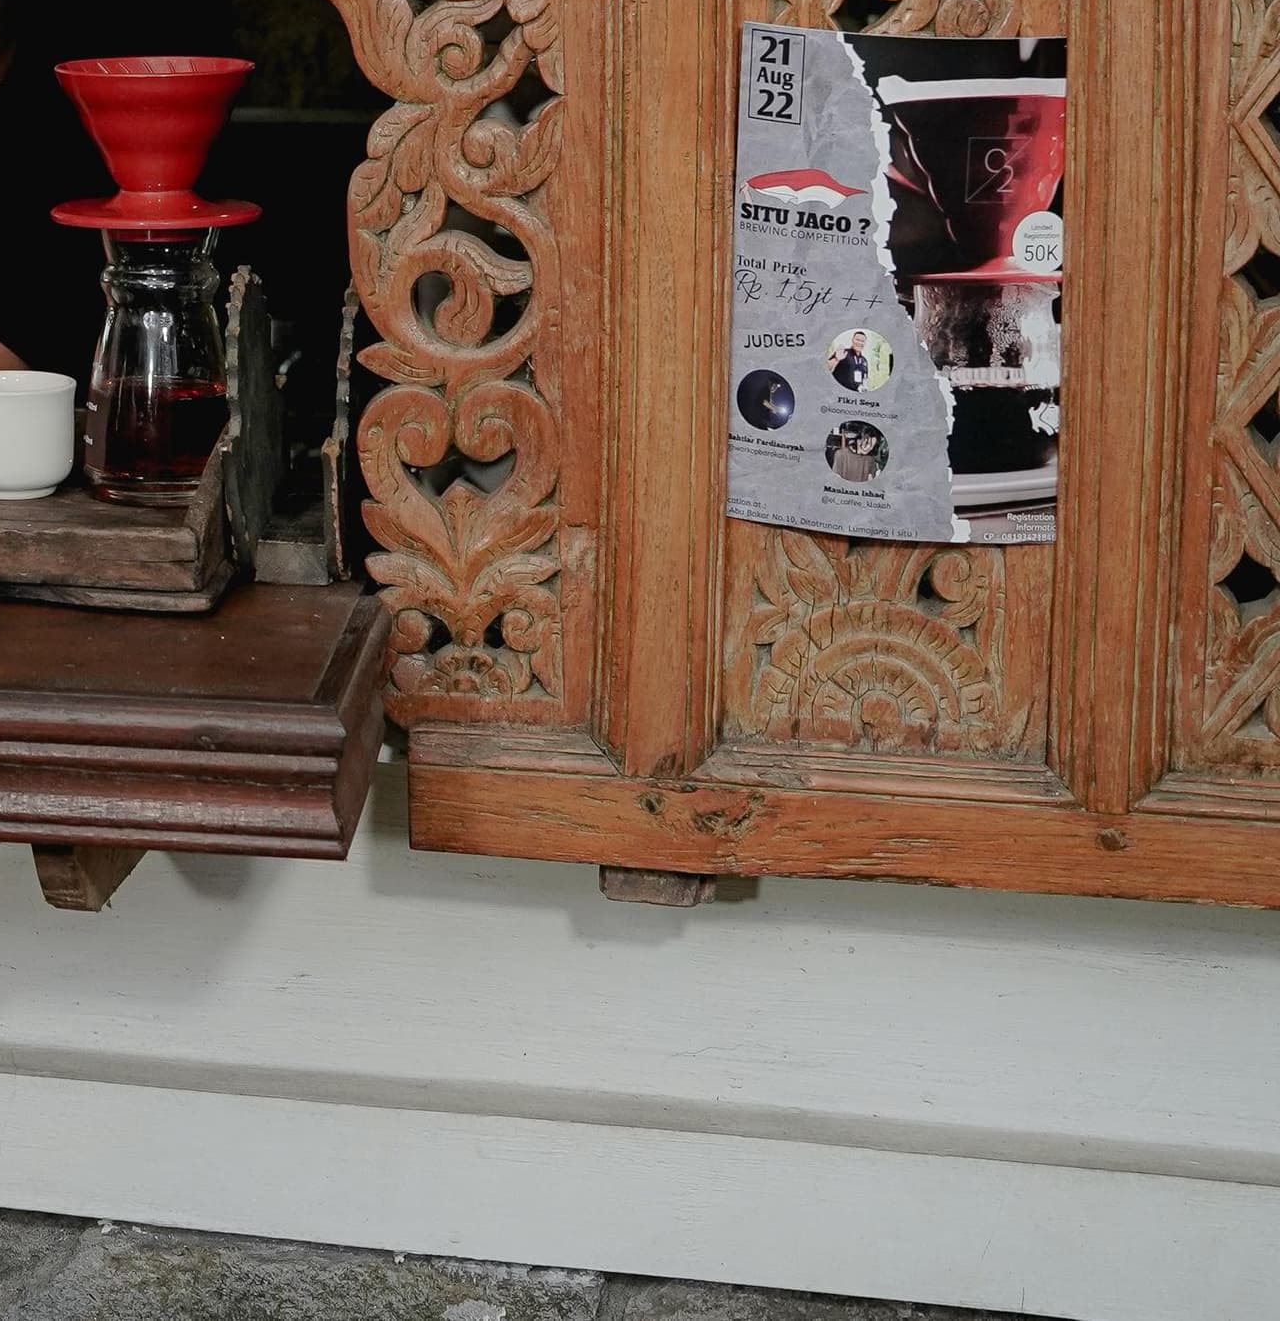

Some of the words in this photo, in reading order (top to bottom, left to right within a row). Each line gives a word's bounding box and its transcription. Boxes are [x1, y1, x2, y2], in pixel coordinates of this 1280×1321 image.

[760, 36, 791, 66] 21
[756, 66, 795, 91] Aug
[757, 89, 794, 119] 22
[741, 202, 790, 226] SITU
[796, 211, 851, 233] JAGO
[858, 218, 871, 235] ?
[739, 222, 788, 238] BREWING
[790, 229, 869, 247] COMPETITION
[1024, 244, 1058, 262] 50K
[736, 255, 766, 270] Total
[773, 261, 807, 277] Prize
[743, 333, 806, 349] JUDGES
[823, 485, 859, 496] Maulana
[1007, 512, 1055, 522] Registration
[1016, 523, 1056, 531] Informatio
